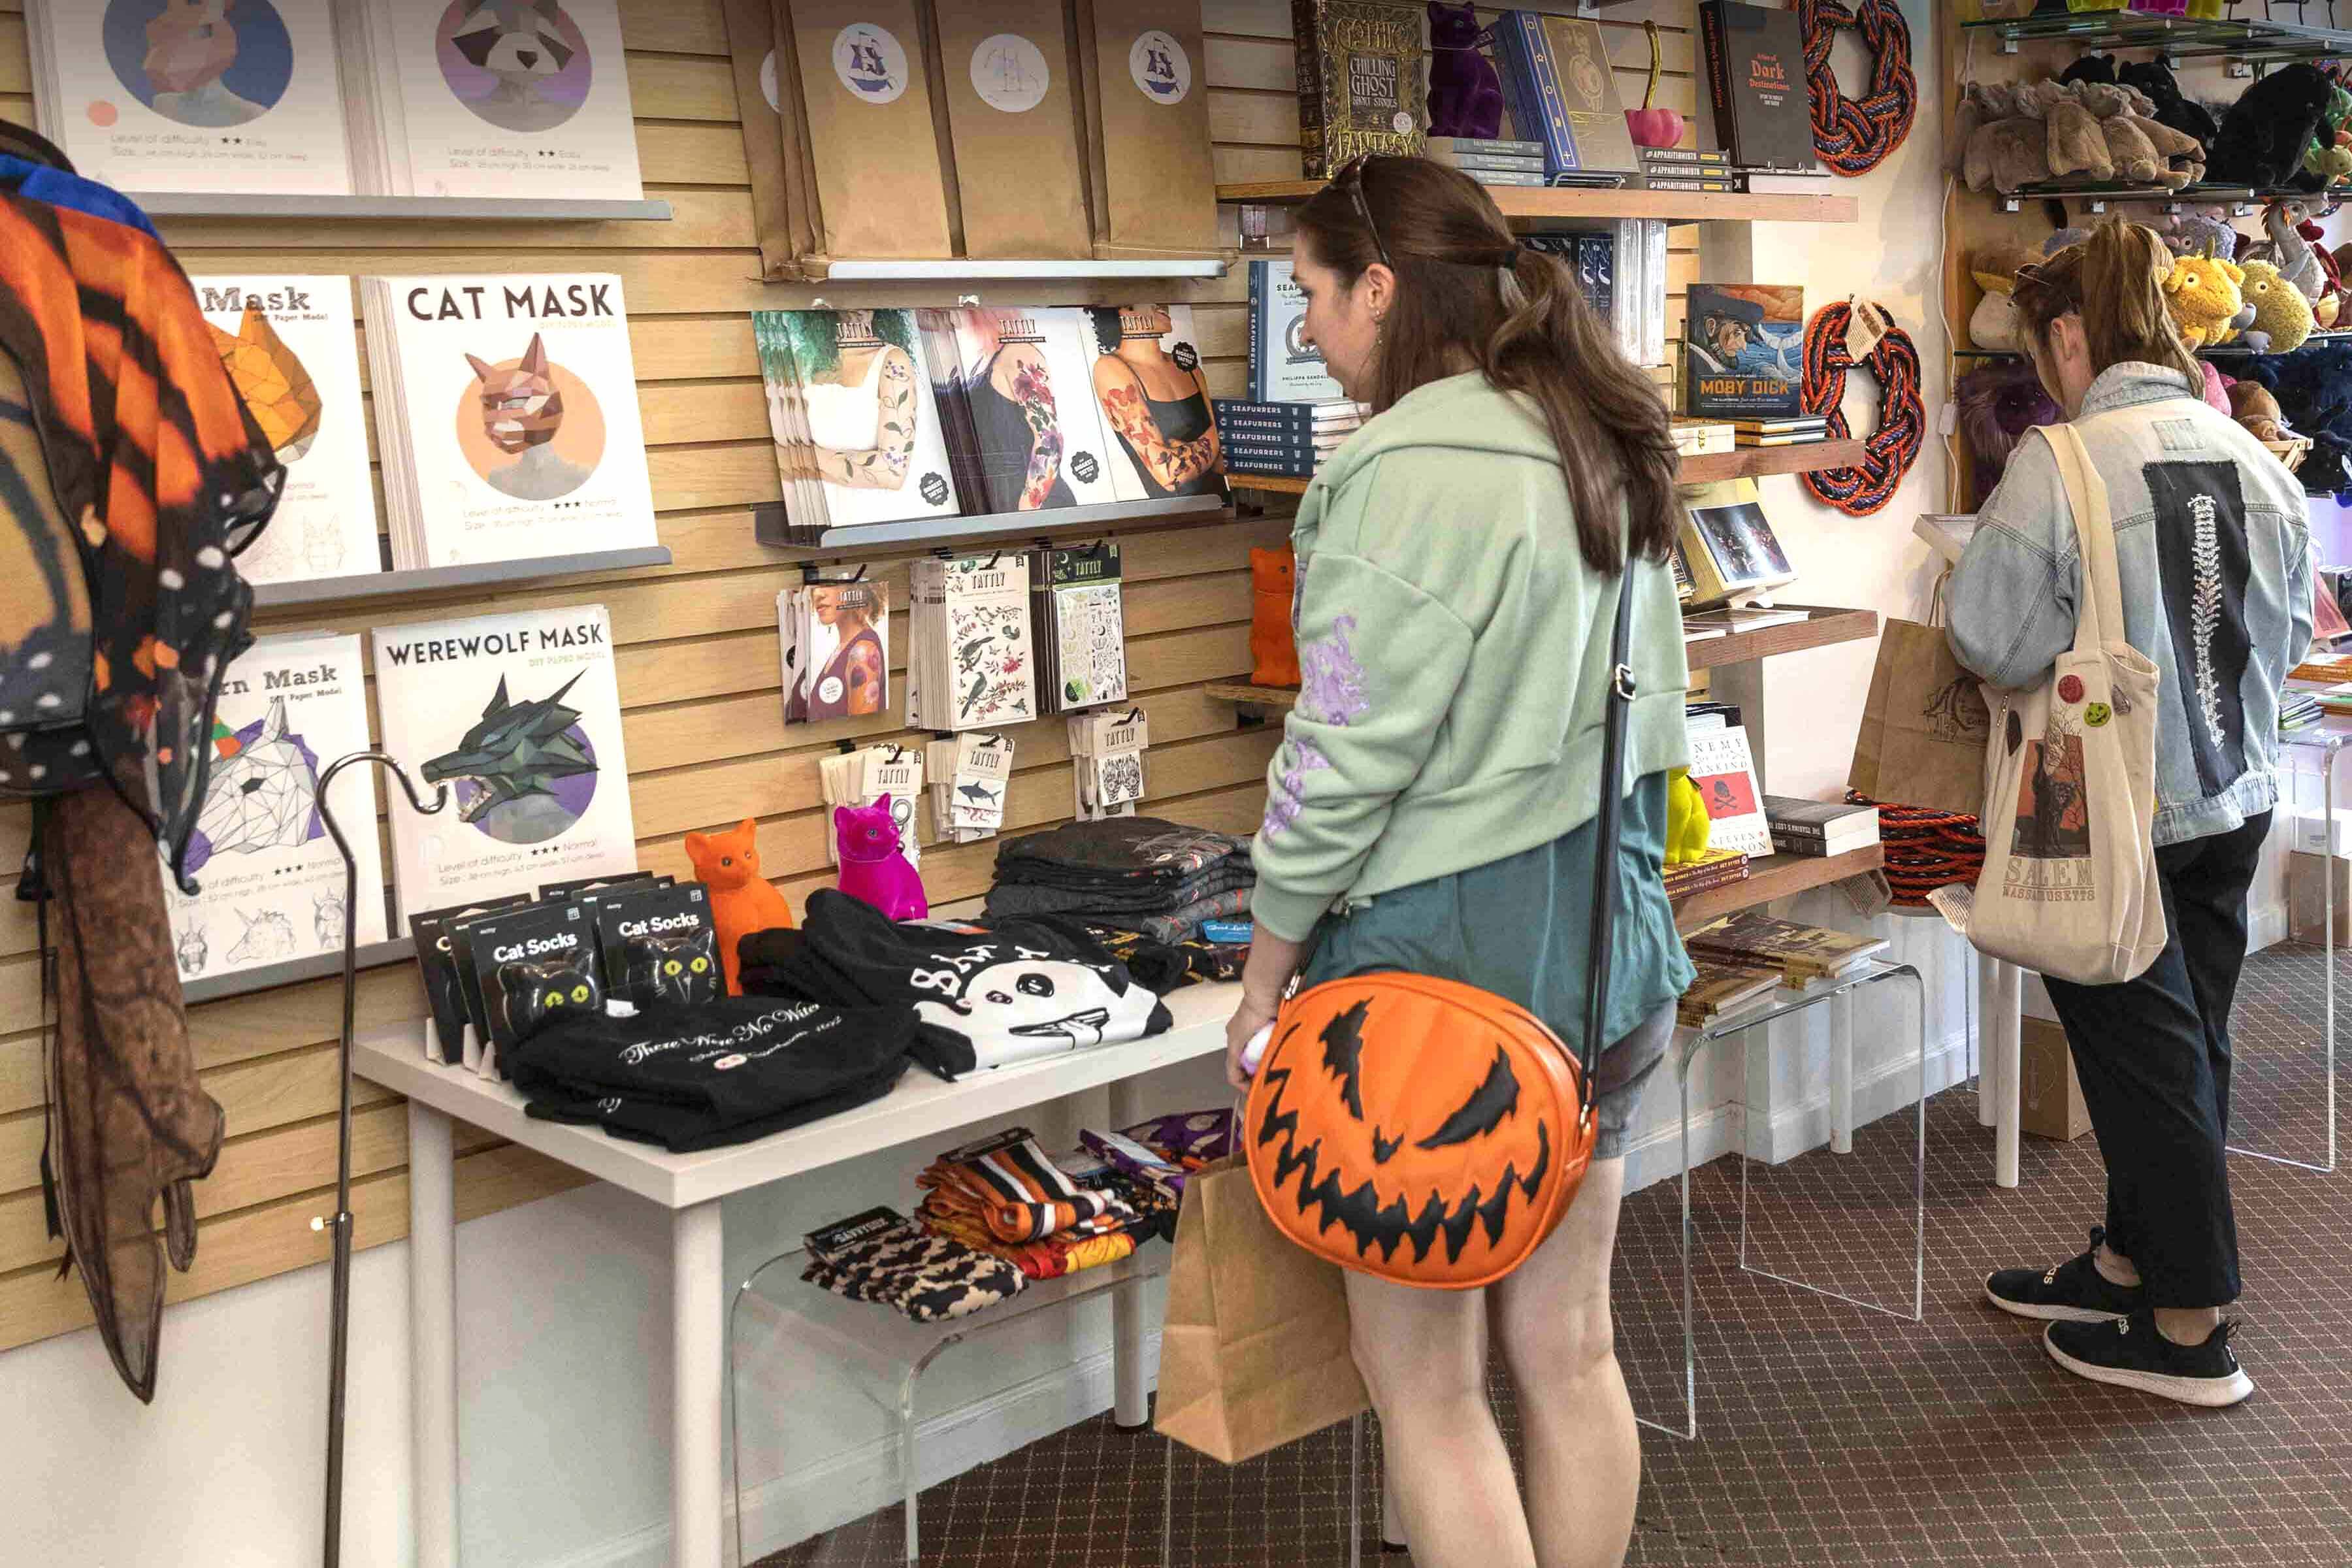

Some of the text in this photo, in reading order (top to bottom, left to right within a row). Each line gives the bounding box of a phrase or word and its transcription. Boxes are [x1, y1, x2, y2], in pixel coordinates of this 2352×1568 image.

[1350, 57, 1396, 76] CHILLING
[1751, 59, 1785, 80] Dark
[1352, 74, 1396, 98] GHOST
[1747, 78, 1791, 91] Destinations
[201, 286, 310, 312] Mask
[408, 284, 614, 320] CAT MASK
[998, 318, 1036, 335] TATTLY
[1119, 313, 1154, 331] TATTLY
[1701, 379, 1788, 396] MOBY DICK
[1232, 405, 1281, 414] SEAFURRERS
[1233, 419, 1282, 428] SEAFURRERS
[1232, 433, 1281, 442] SEAFURRERS
[1233, 448, 1284, 457] SEAFURRERS
[1235, 461, 1283, 470] SEAFURRERS
[1077, 560, 1103, 576] TATTLY
[972, 572, 1005, 589] TATTLY
[387, 623, 604, 666] WEREWOLF MASK
[263, 664, 337, 690] Mask
[289, 692, 313, 702] Paper
[316, 687, 342, 697] Model
[1104, 727, 1135, 747] TATTLY
[1694, 738, 1742, 754] NEMY
[970, 751, 1000, 768] TATTLY
[877, 768, 910, 784] TATTLY
[1711, 832, 1755, 845] STEVEN
[2005, 857, 2095, 887] SALEM
[619, 912, 700, 937] Cat Socks
[493, 932, 578, 962] Cat Socks
[619, 1040, 687, 1064] There
[732, 1015, 774, 1041] No
